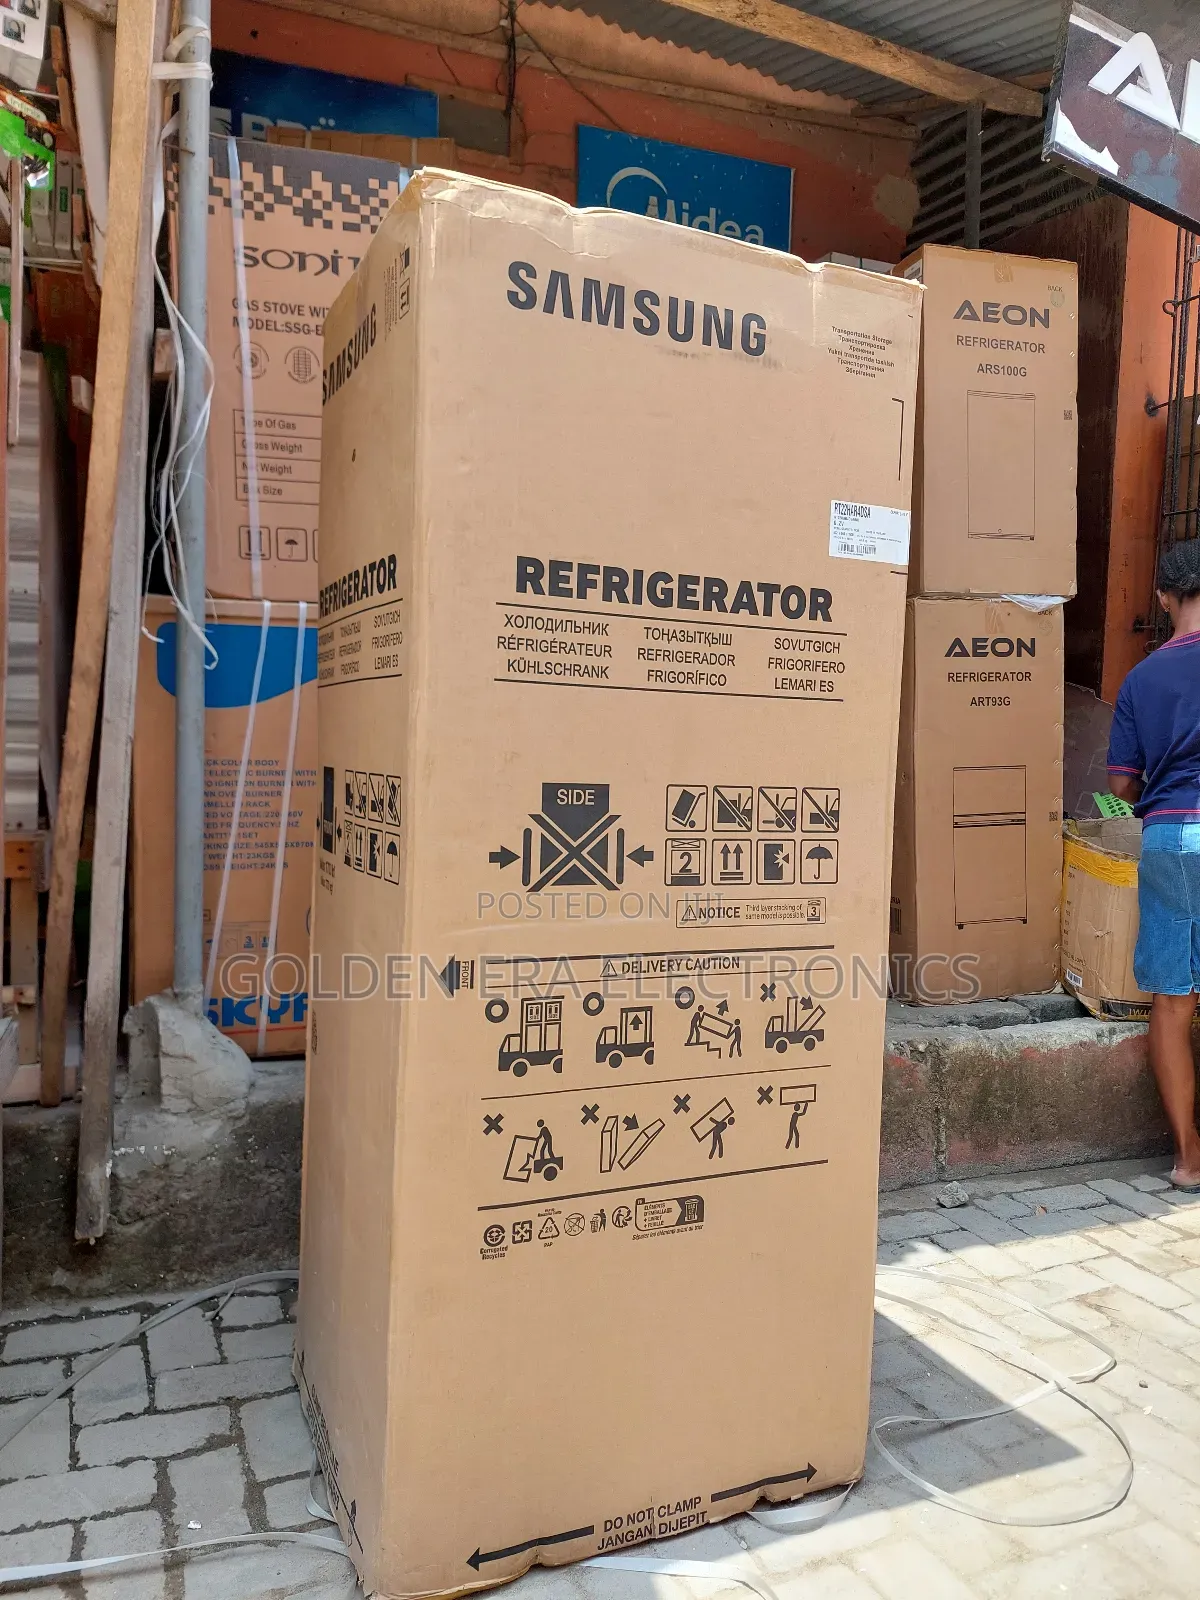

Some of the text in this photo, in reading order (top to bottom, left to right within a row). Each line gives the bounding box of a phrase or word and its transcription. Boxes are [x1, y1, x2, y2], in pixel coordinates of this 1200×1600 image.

[263, 301, 305, 316] STOVE
[507, 261, 767, 356] SAMSUNG
[953, 300, 1050, 328] AEON
[956, 335, 1046, 353] REFRIGERATOR
[977, 363, 1027, 377] ARS100G
[241, 416, 297, 431] Tpe Of Gas
[271, 441, 303, 455] Weight
[261, 462, 292, 476] Weight
[263, 485, 283, 496] Size
[319, 554, 397, 618] REFRIGERATOR
[516, 555, 833, 623] REFRIGERATOR
[504, 613, 609, 636] ХОЛОДИЛЬНИК
[497, 635, 612, 658] RÉFRIGÉRATEUR
[774, 637, 841, 654] SOVUTGICH
[944, 637, 1036, 658] AEON
[637, 648, 736, 667] REFRIGERADOR
[768, 657, 845, 674] FRIGORIFERO
[507, 659, 609, 679] KÜHLSCHRANK
[647, 668, 727, 686] FRIGORÍFICO
[947, 671, 1032, 682] REFRIGERATOR
[774, 677, 835, 693] LEMARI ES
[970, 696, 1011, 707] ART93G
[556, 788, 595, 805] SIDE
[679, 852, 692, 874] 2
[698, 906, 741, 919] NOTICE
[621, 956, 740, 974] DELIVERY CAUTION
[461, 960, 470, 989] FRONT
[604, 1496, 702, 1532] DO NOT CLAMP
[597, 1510, 708, 1551] JANGAN DIJEPIT
